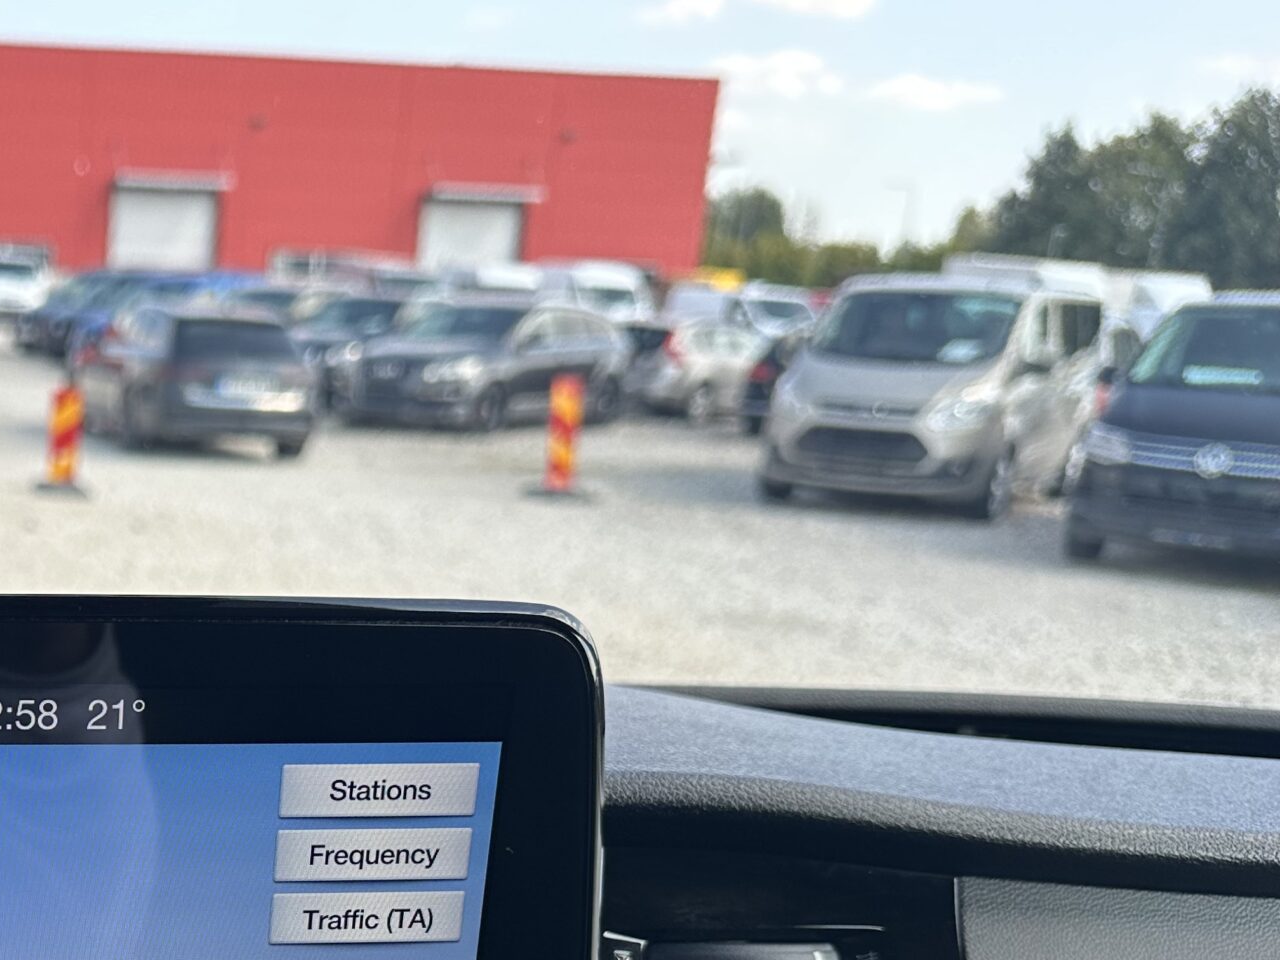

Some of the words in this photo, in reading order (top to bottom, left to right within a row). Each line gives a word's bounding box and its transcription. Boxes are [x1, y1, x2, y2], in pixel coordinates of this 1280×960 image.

[329, 778, 433, 802] Stations
[309, 844, 441, 870] Frequency
[303, 909, 380, 931] Traffic
[386, 907, 435, 935] (TA)
